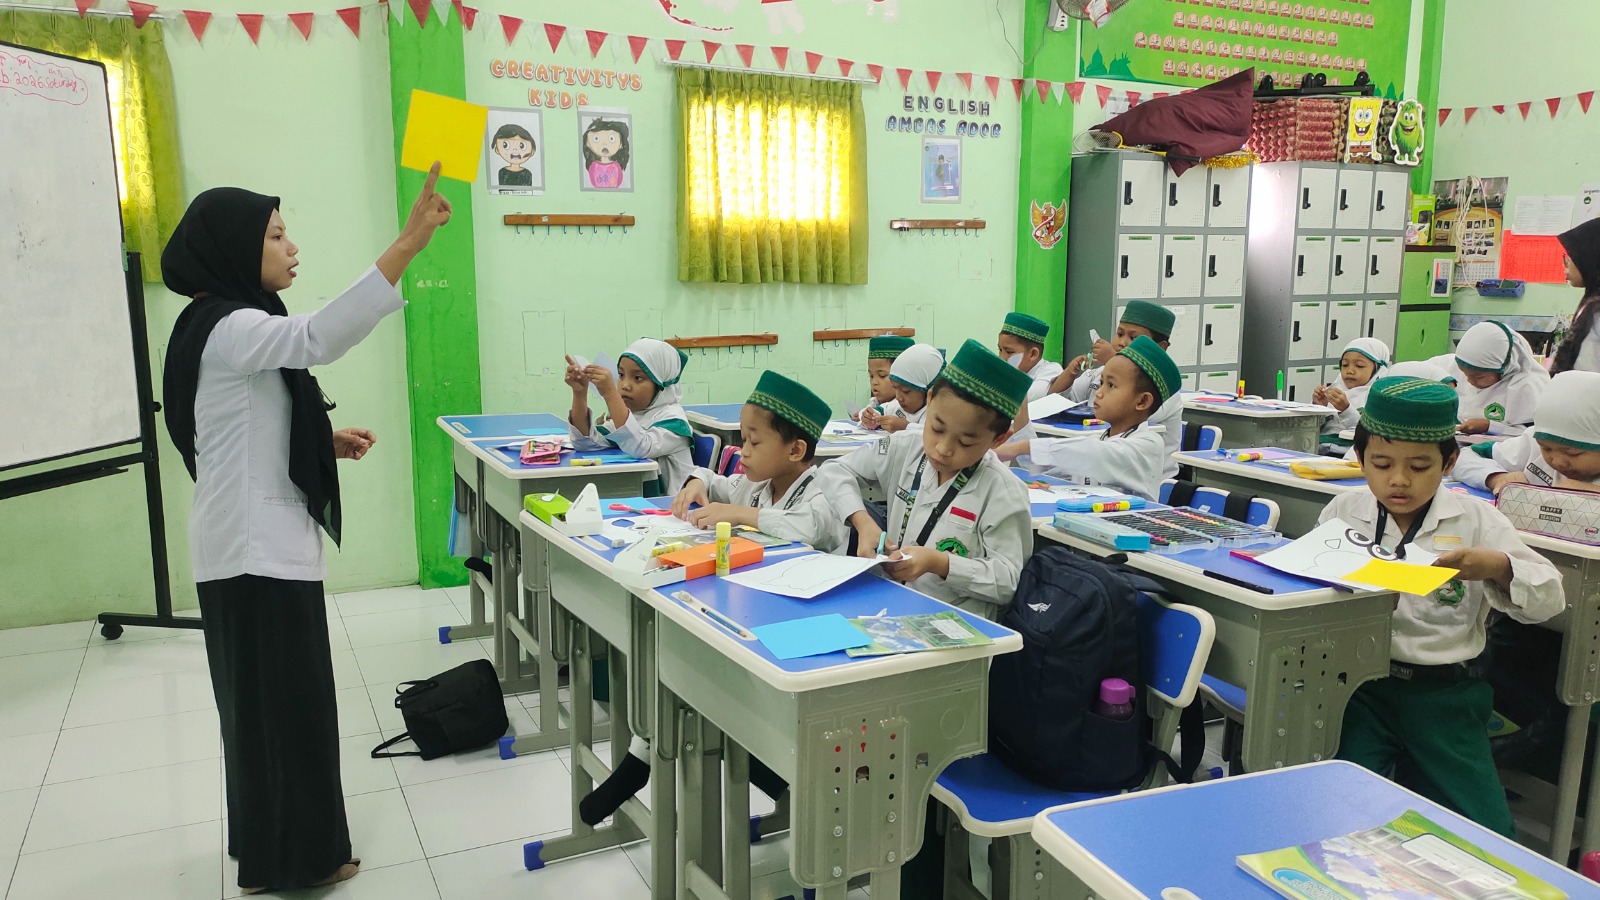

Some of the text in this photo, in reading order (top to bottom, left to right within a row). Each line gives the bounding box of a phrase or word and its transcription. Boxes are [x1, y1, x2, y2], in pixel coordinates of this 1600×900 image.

[490, 59, 642, 91] CREATIVITYS
[528, 87, 589, 109] KIDS
[903, 95, 991, 116] ENGLISH
[1539, 514, 1561, 522] SEASON
[1540, 506, 1562, 514] HAPPY
